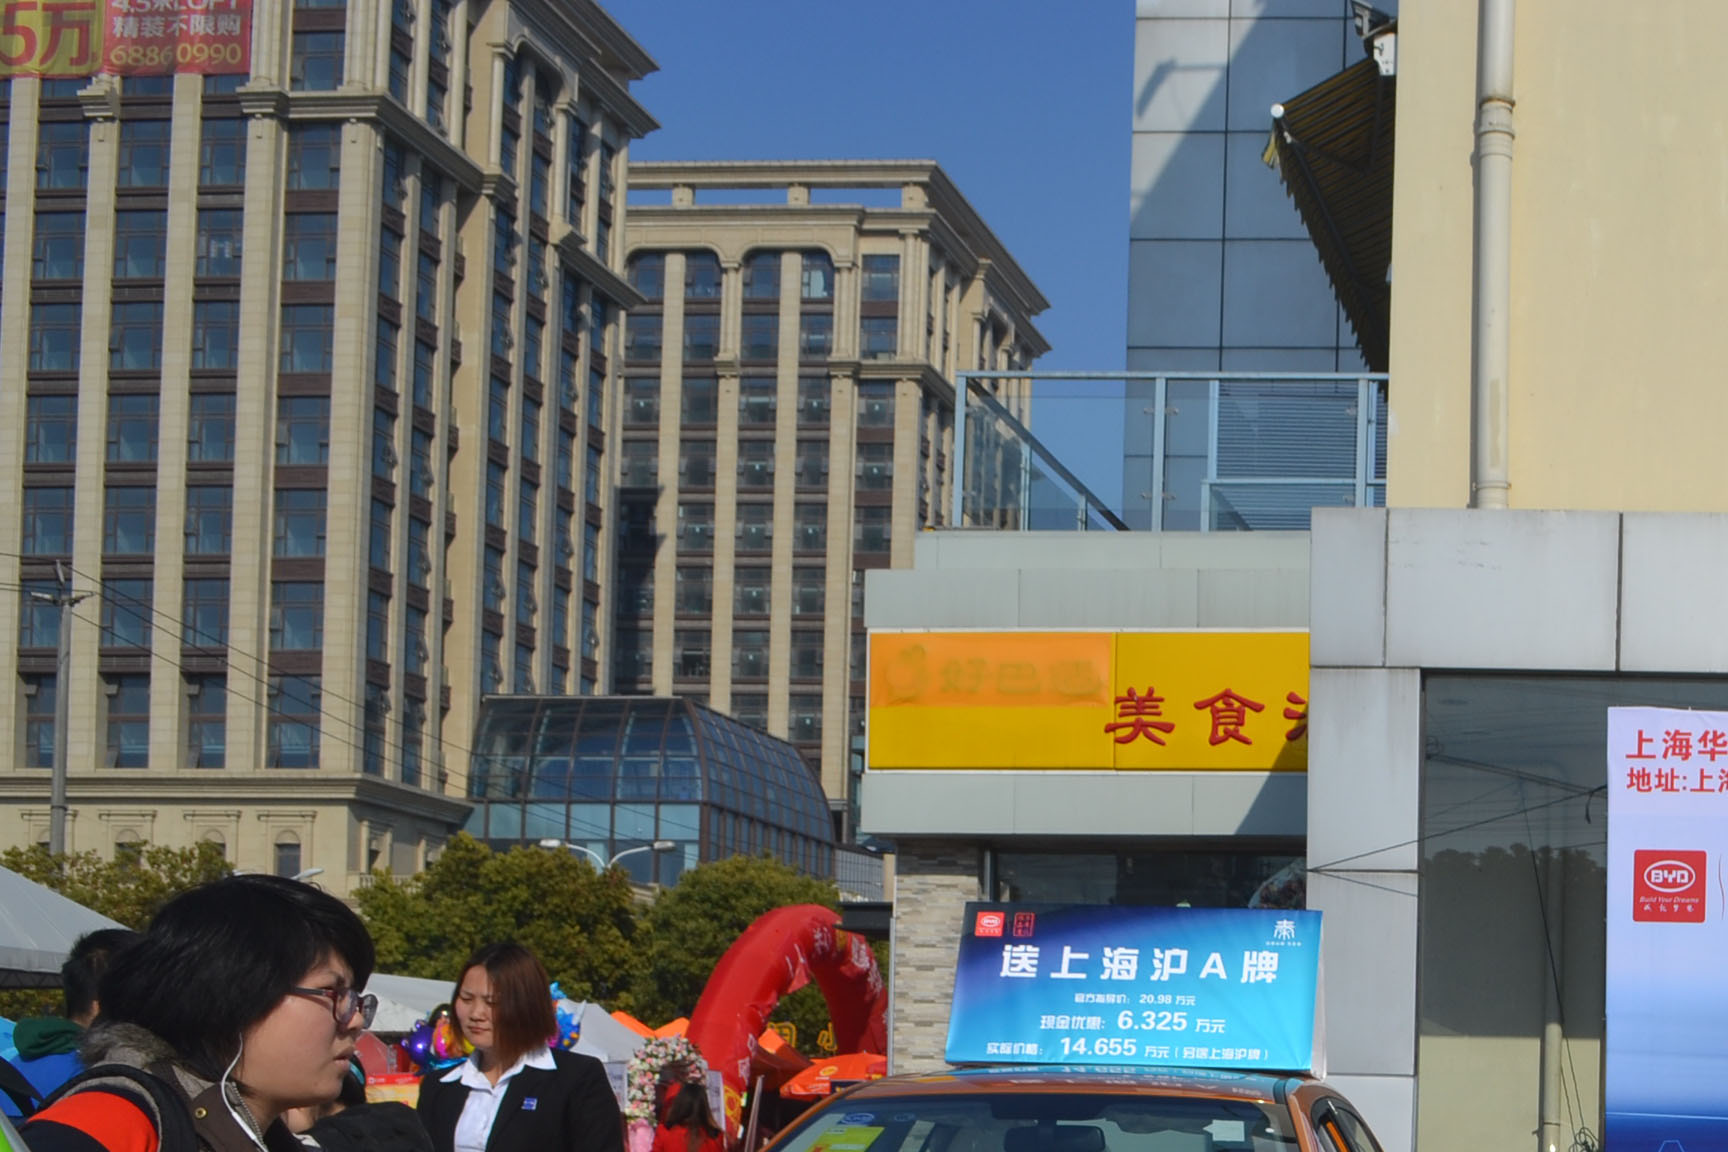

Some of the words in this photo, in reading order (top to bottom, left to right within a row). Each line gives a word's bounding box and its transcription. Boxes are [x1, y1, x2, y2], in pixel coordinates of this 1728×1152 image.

[1650, 869, 1690, 884] BYD
[1139, 993, 1172, 1006] 20.98
[1116, 1010, 1188, 1032] 6.325
[1195, 1018, 1227, 1034] 万元
[1059, 1036, 1138, 1057] 14.655
